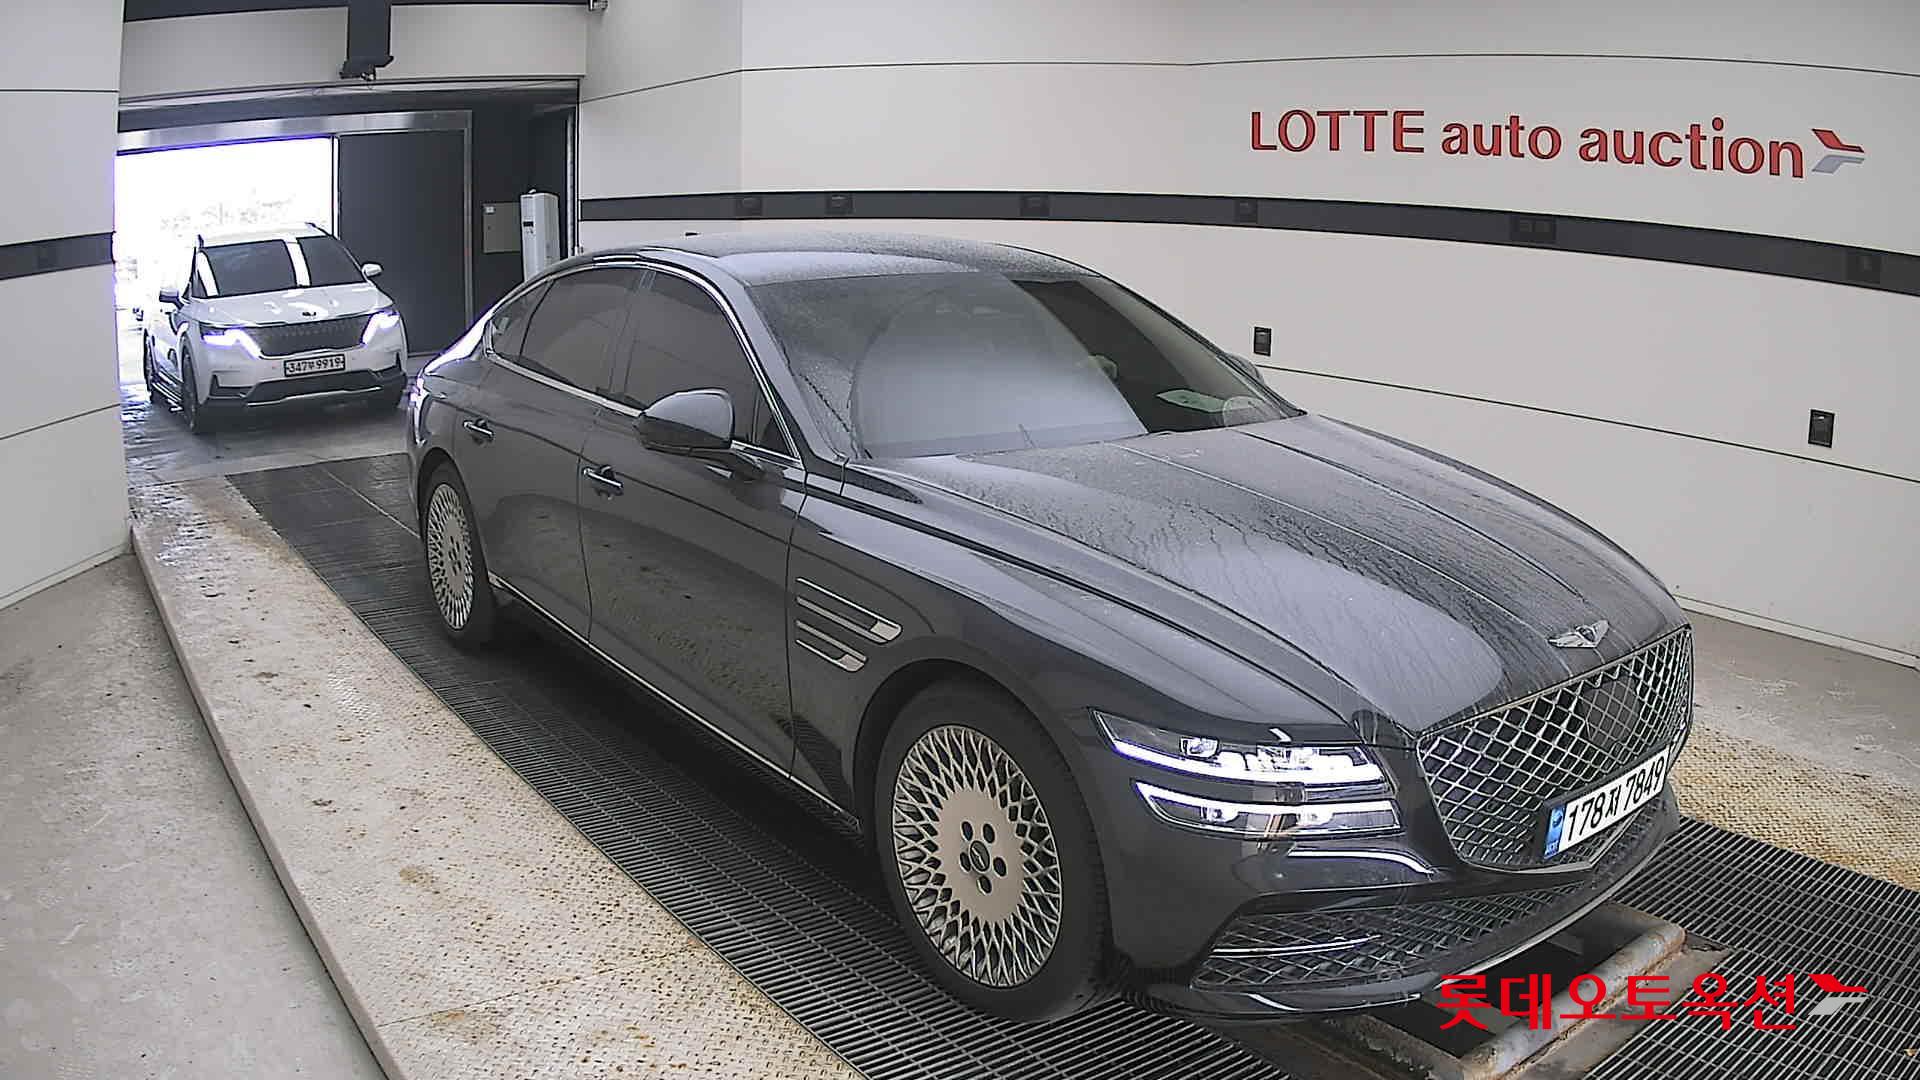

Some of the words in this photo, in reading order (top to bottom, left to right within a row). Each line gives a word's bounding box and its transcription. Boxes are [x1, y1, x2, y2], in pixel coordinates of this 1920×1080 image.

[1250, 110, 1425, 153] LOTTE
[1441, 116, 1562, 160] auto
[1578, 117, 1804, 179] auction
[1568, 784, 1622, 841] 178저
[1623, 756, 1665, 811] 7849
